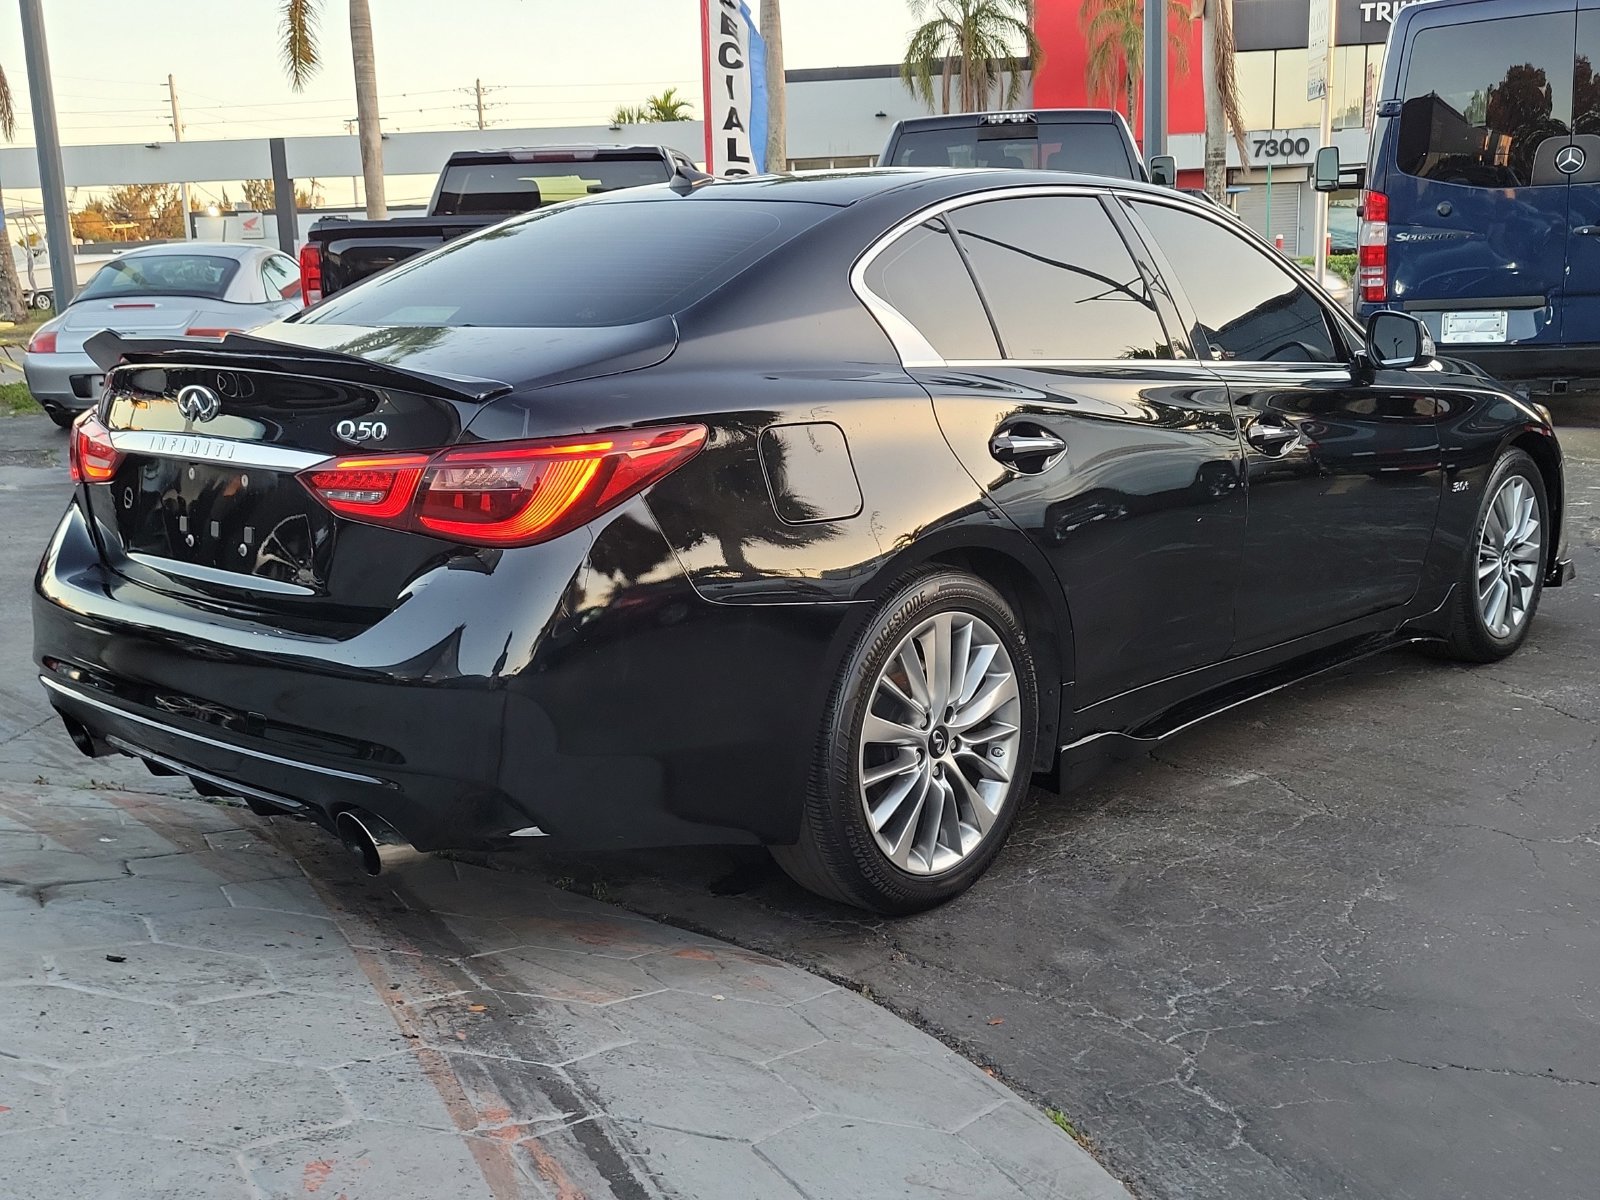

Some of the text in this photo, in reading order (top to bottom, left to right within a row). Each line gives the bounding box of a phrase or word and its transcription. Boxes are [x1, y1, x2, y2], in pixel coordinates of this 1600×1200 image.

[1252, 137, 1310, 158] 7300
[336, 419, 387, 445] Q50
[148, 435, 236, 459] INFINITI
[857, 589, 927, 680] BRIDGESTONE
